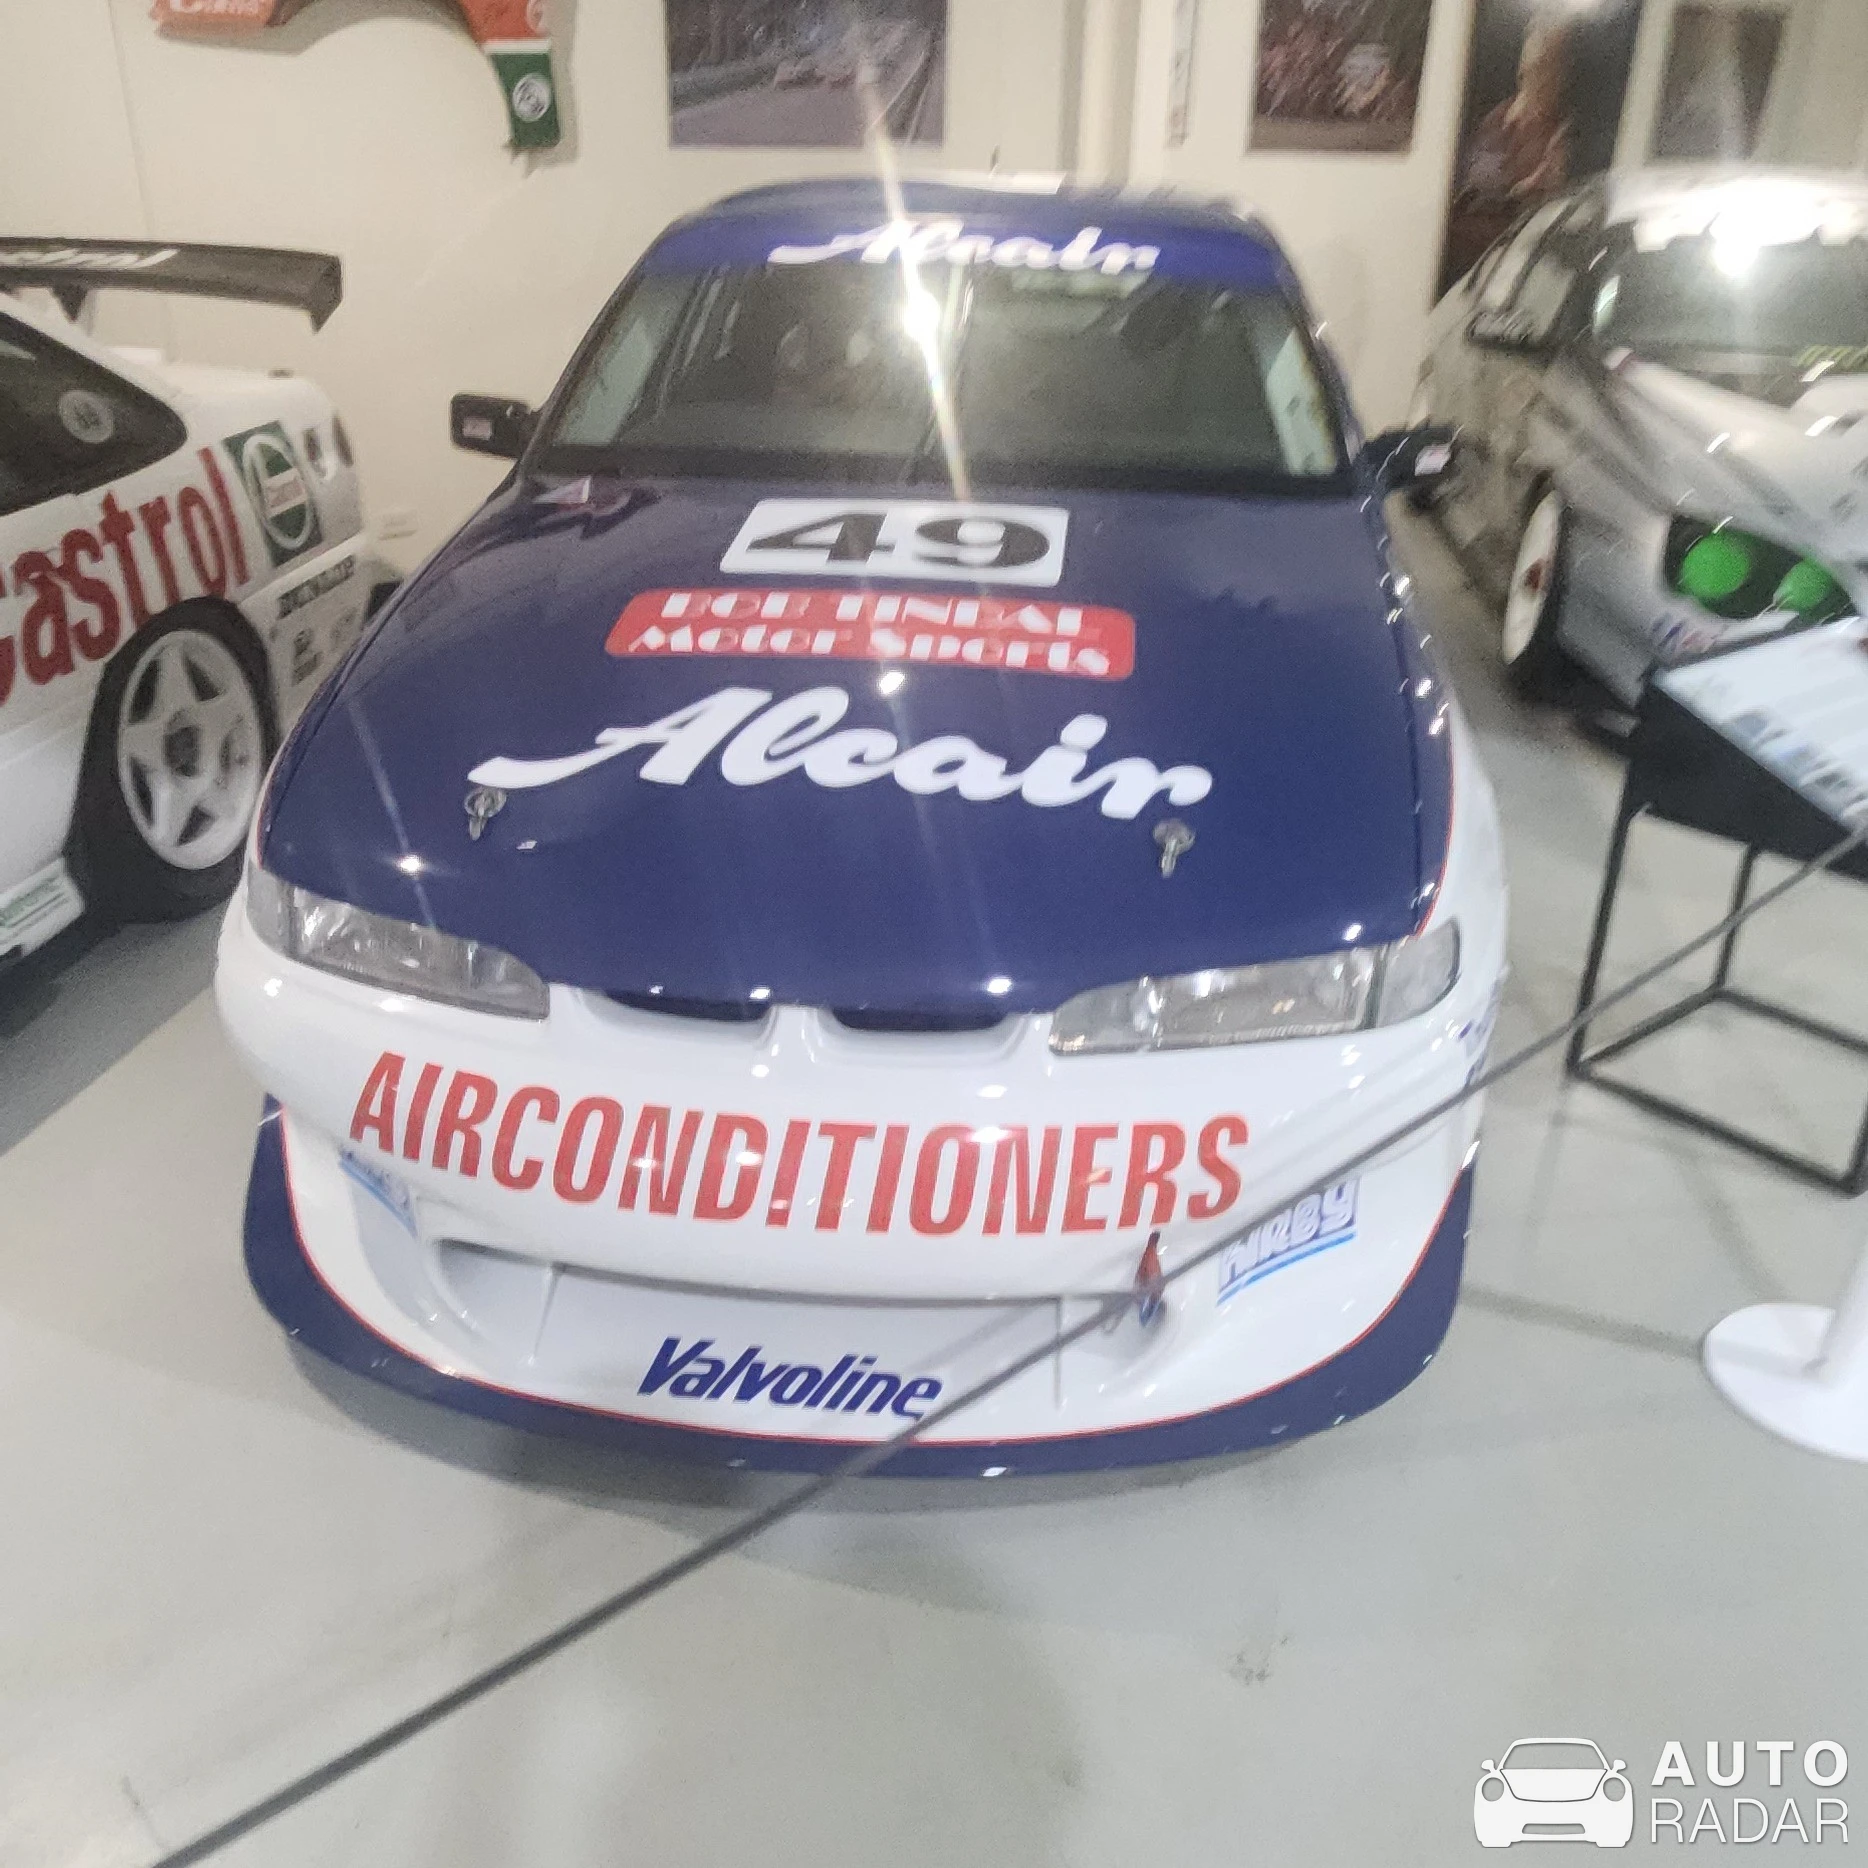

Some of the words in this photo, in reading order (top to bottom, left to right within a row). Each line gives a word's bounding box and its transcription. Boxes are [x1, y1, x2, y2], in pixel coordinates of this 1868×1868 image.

[747, 511, 1051, 569] 49
[627, 623, 853, 656] Motor
[869, 627, 1111, 677] Sports
[466, 685, 1214, 820] Alcair
[348, 1050, 1250, 1236] AIRCONDITIONERS
[637, 1335, 944, 1420] Valvoline
